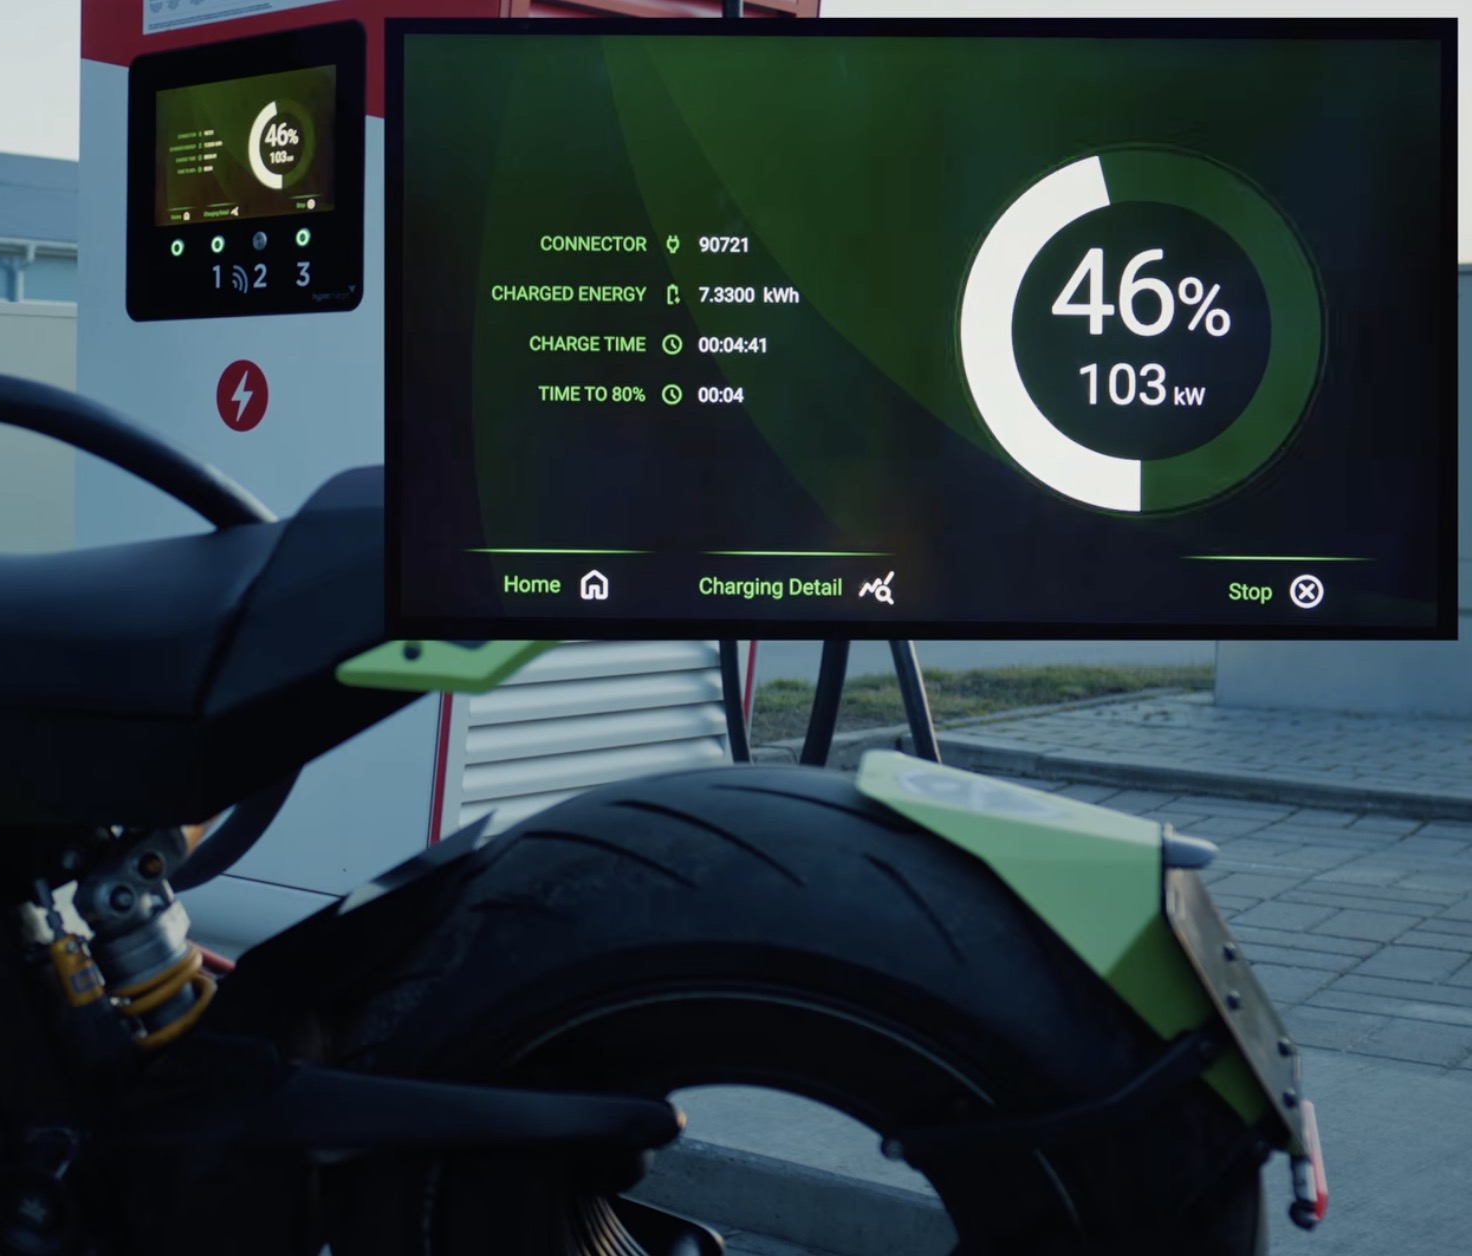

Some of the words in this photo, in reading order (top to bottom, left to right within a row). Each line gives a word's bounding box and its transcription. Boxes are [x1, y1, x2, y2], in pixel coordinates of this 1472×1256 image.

[264, 121, 299, 147] 46%
[269, 150, 287, 164] 103
[540, 235, 647, 252] CONNECTOR
[698, 236, 750, 253] 90721
[212, 265, 221, 289] 1
[253, 263, 267, 288] 2
[295, 261, 311, 287] 3
[491, 285, 574, 302] CHARGED
[578, 285, 647, 302] ENERGY
[698, 286, 755, 304] 7.3300
[763, 286, 800, 304] kWh
[1051, 247, 1231, 337] 46%
[529, 335, 600, 352] CHARGE
[603, 336, 647, 352] TIME
[698, 336, 768, 354] 00:04:41
[538, 385, 581, 402] TIME
[583, 385, 608, 402] TO
[611, 386, 646, 403] 80%
[697, 386, 745, 404] 00:04
[1079, 362, 1167, 407] 103
[1173, 385, 1207, 406] kW
[504, 575, 561, 594] Home
[698, 576, 784, 600] Charging
[789, 577, 843, 596] Detail
[1228, 582, 1273, 605] Stop
